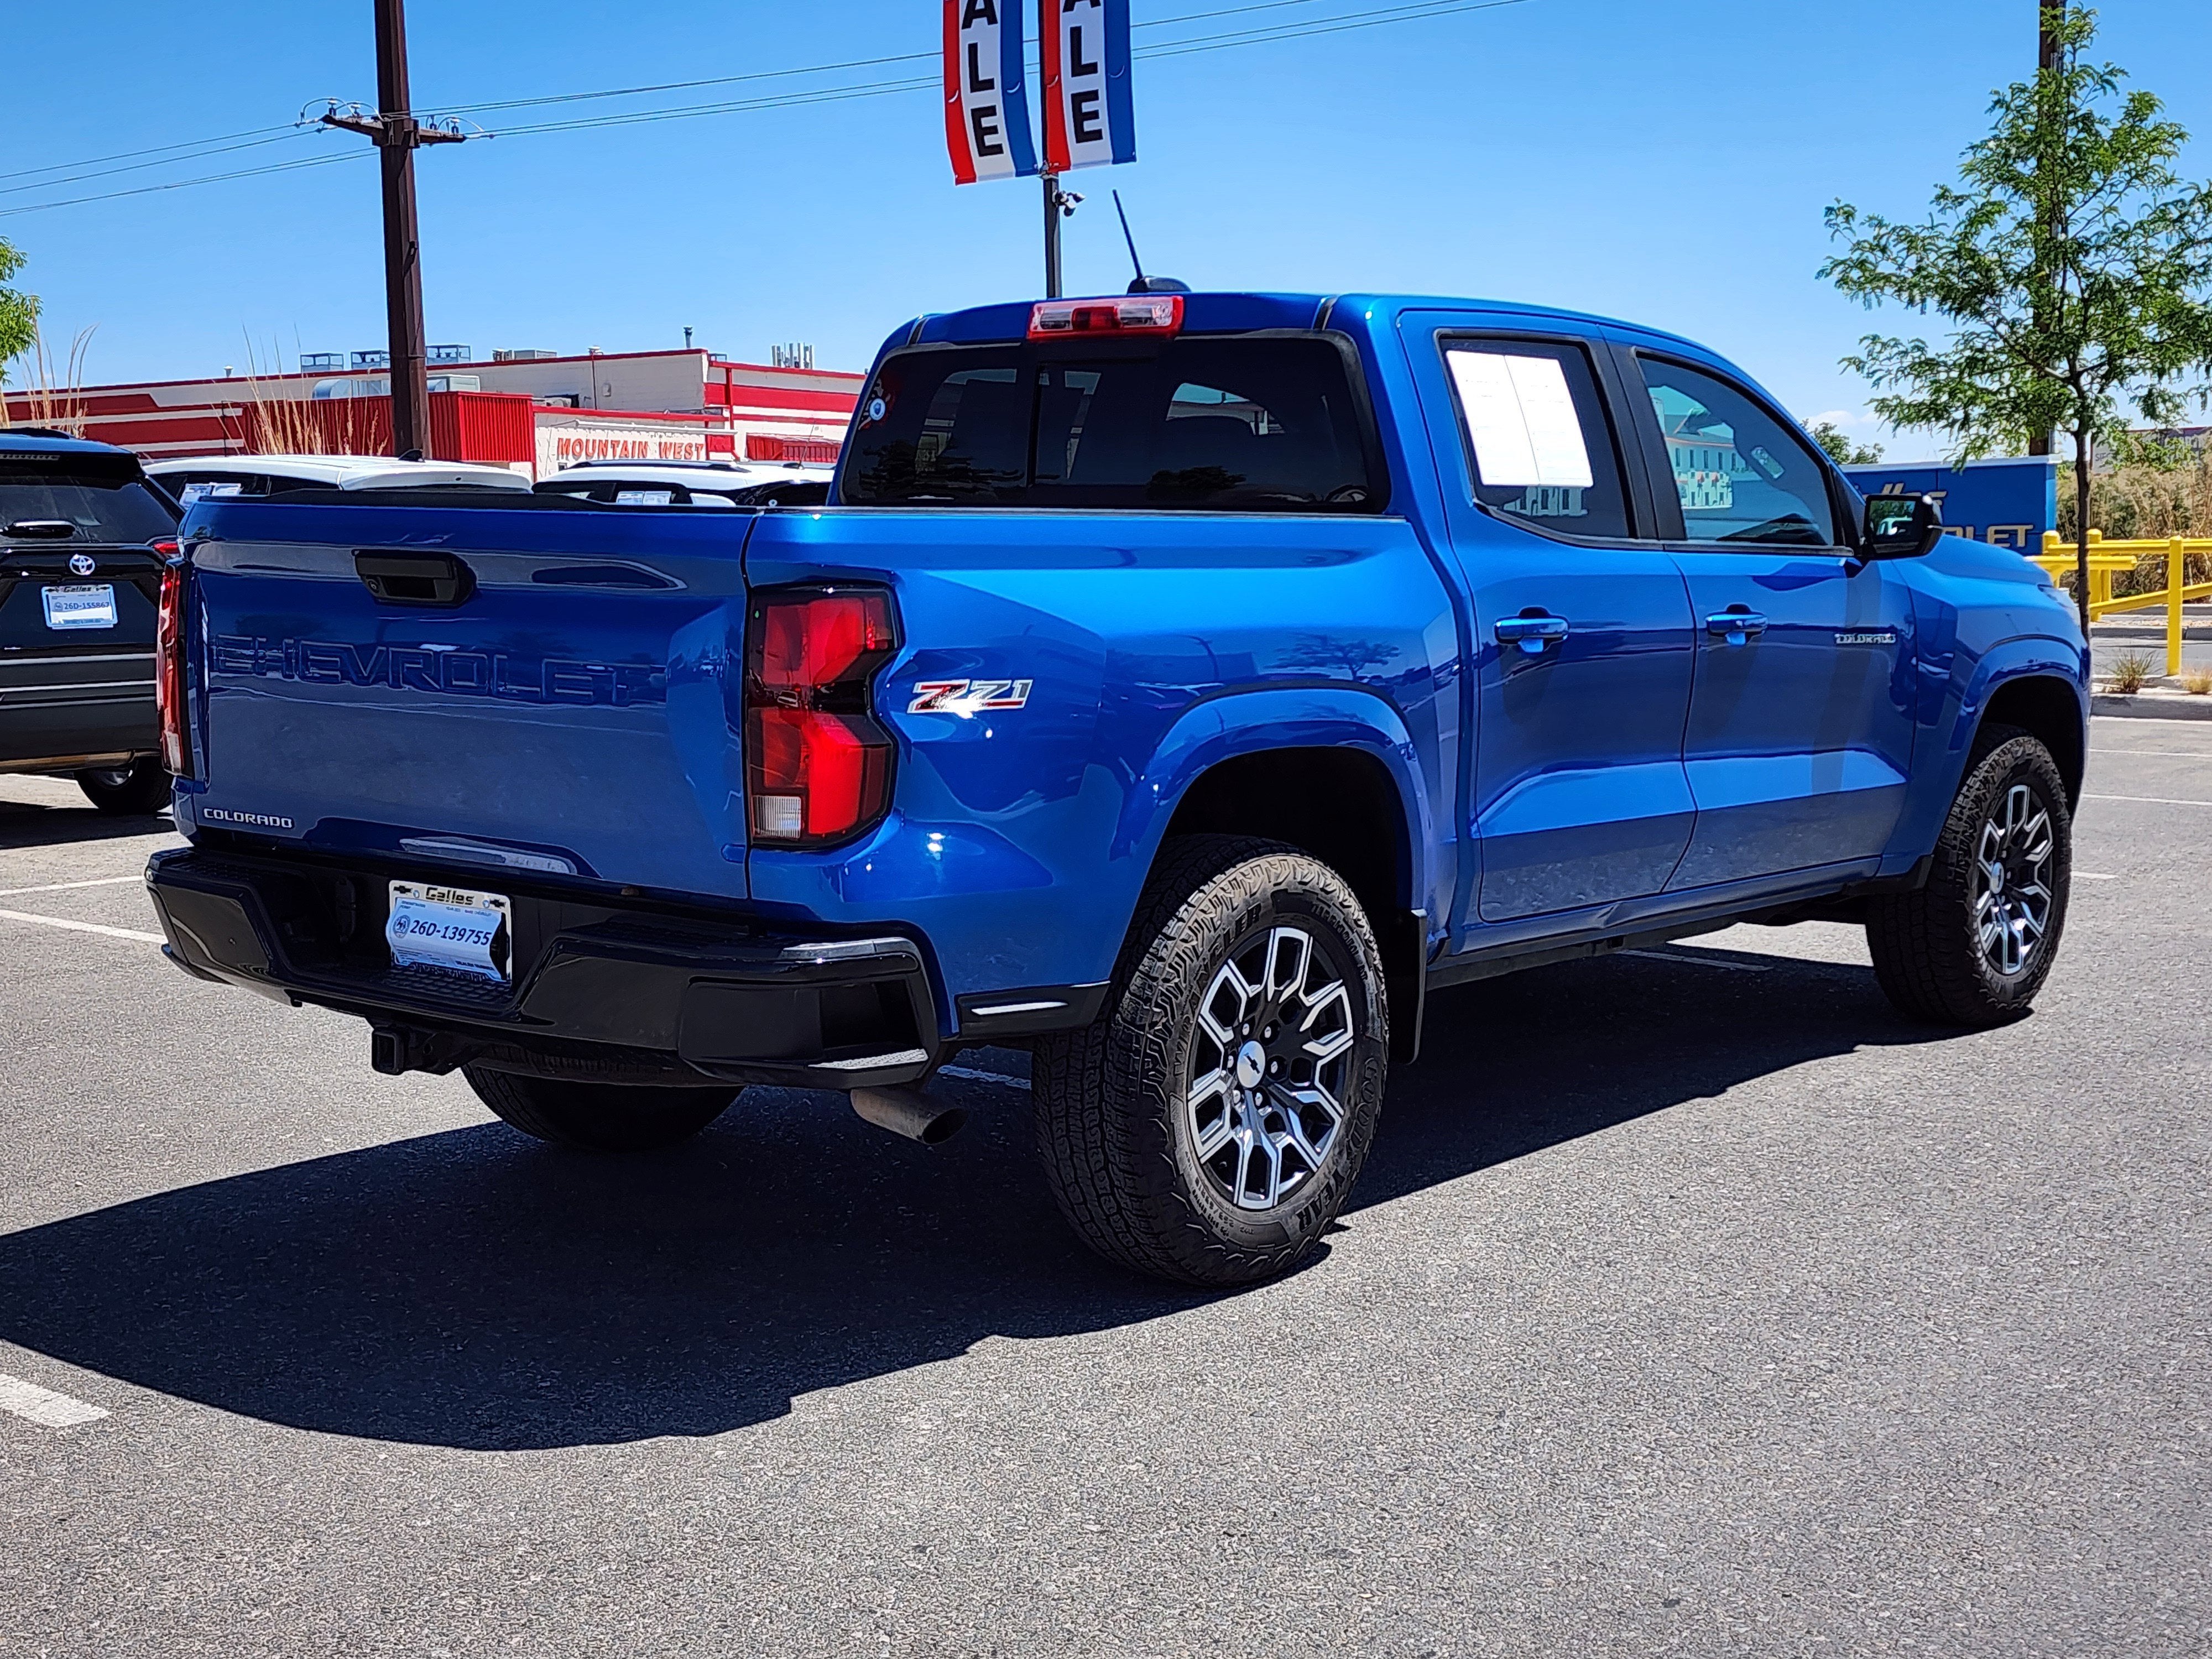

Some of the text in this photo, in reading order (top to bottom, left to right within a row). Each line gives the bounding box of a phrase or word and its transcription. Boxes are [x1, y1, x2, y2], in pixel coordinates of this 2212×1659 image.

[1062, 0, 1103, 144] LE
[557, 437, 704, 460] MOUNTAIN WEST
[212, 634, 655, 706] CHEVROLET
[907, 679, 1033, 714] Z71
[204, 808, 293, 828] COLORADO
[425, 886, 475, 906] Galles
[410, 919, 492, 946] 26D-139755
[1296, 1057, 1379, 1233] GOODYEAR
